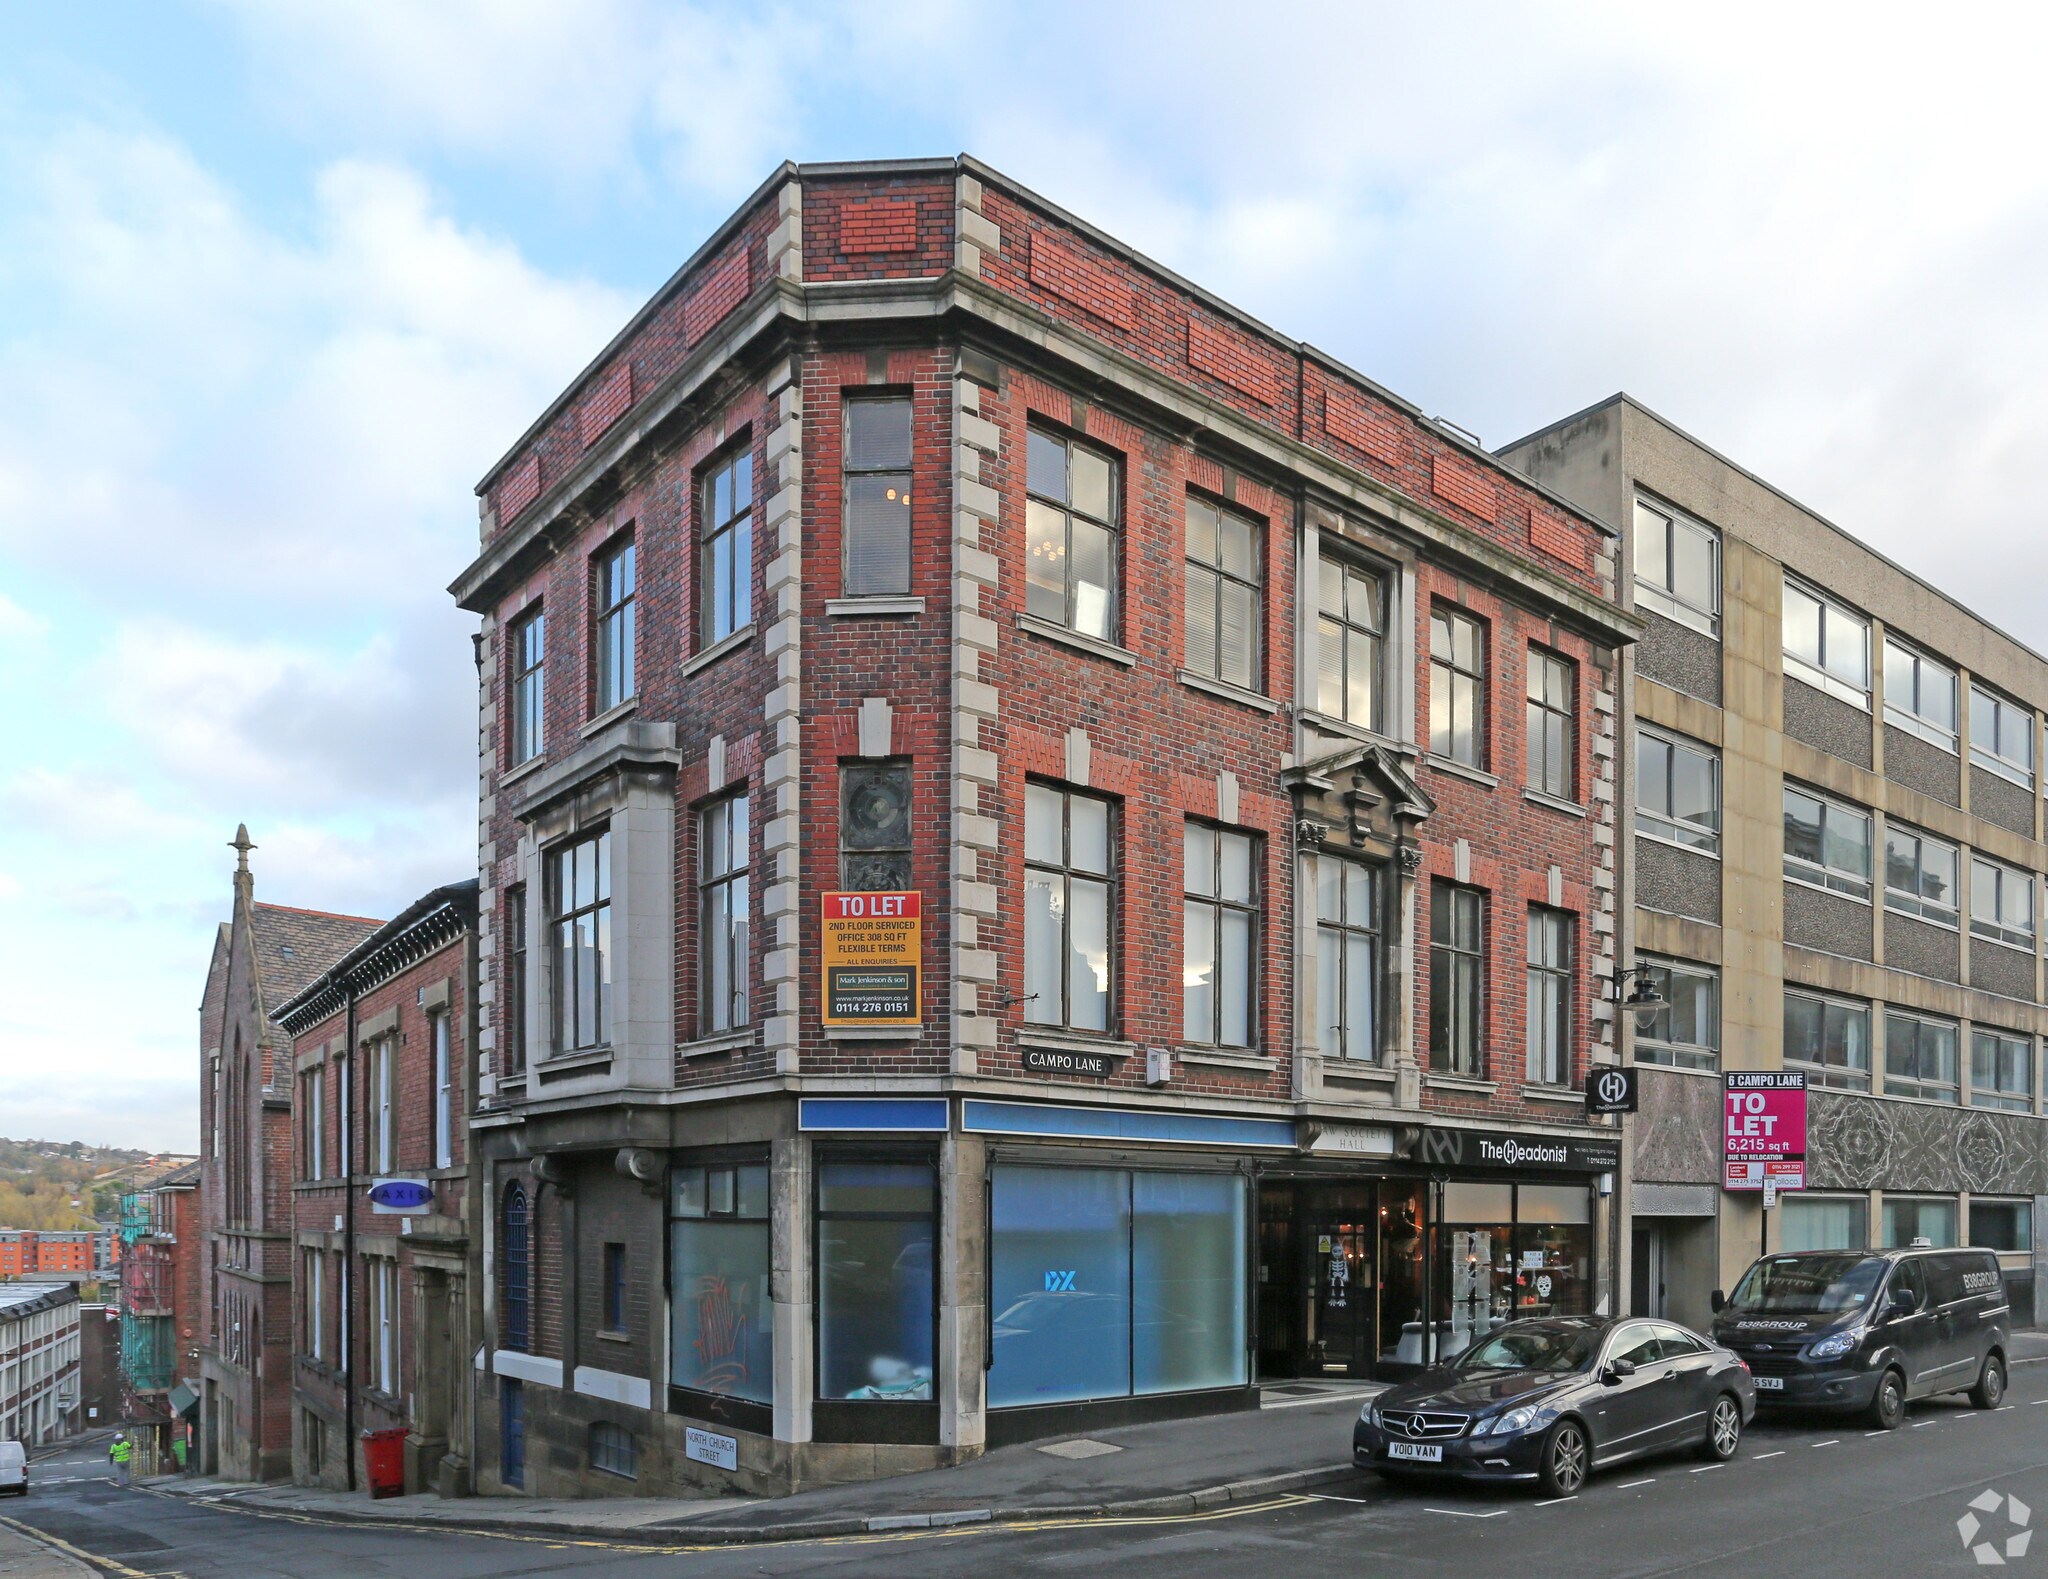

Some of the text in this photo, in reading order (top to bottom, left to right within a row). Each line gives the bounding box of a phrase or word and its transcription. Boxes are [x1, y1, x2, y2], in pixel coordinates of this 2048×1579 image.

[838, 896, 906, 916] TO LET
[828, 921, 916, 931] 2ND FLOOR SERVICED
[837, 932, 907, 942] OFFICE 308 SQ FT
[838, 944, 906, 953] FLEXIBLE TERMS
[857, 976, 887, 984] Jenkinson
[836, 1003, 908, 1012] 0114 276 0151
[1029, 1052, 1102, 1072] CAMPO LANE
[1728, 1075, 1803, 1086] 6 CAMPO LANE
[1728, 1092, 1766, 1114] TO
[1727, 1115, 1778, 1136] LET
[1344, 1126, 1388, 1139] SOCIETY
[1339, 1139, 1366, 1150] HALL
[1727, 1138, 1790, 1153] 6,215 sq ft
[381, 1189, 424, 1200] AXIS
[1045, 1270, 1076, 1291] DX
[1962, 1271, 1998, 1289] B38GROUP
[1761, 1379, 1779, 1388] SVJ
[687, 1431, 735, 1452] NORTH CHURCH
[698, 1447, 720, 1462] STREET
[1416, 1445, 1436, 1458] VAN
